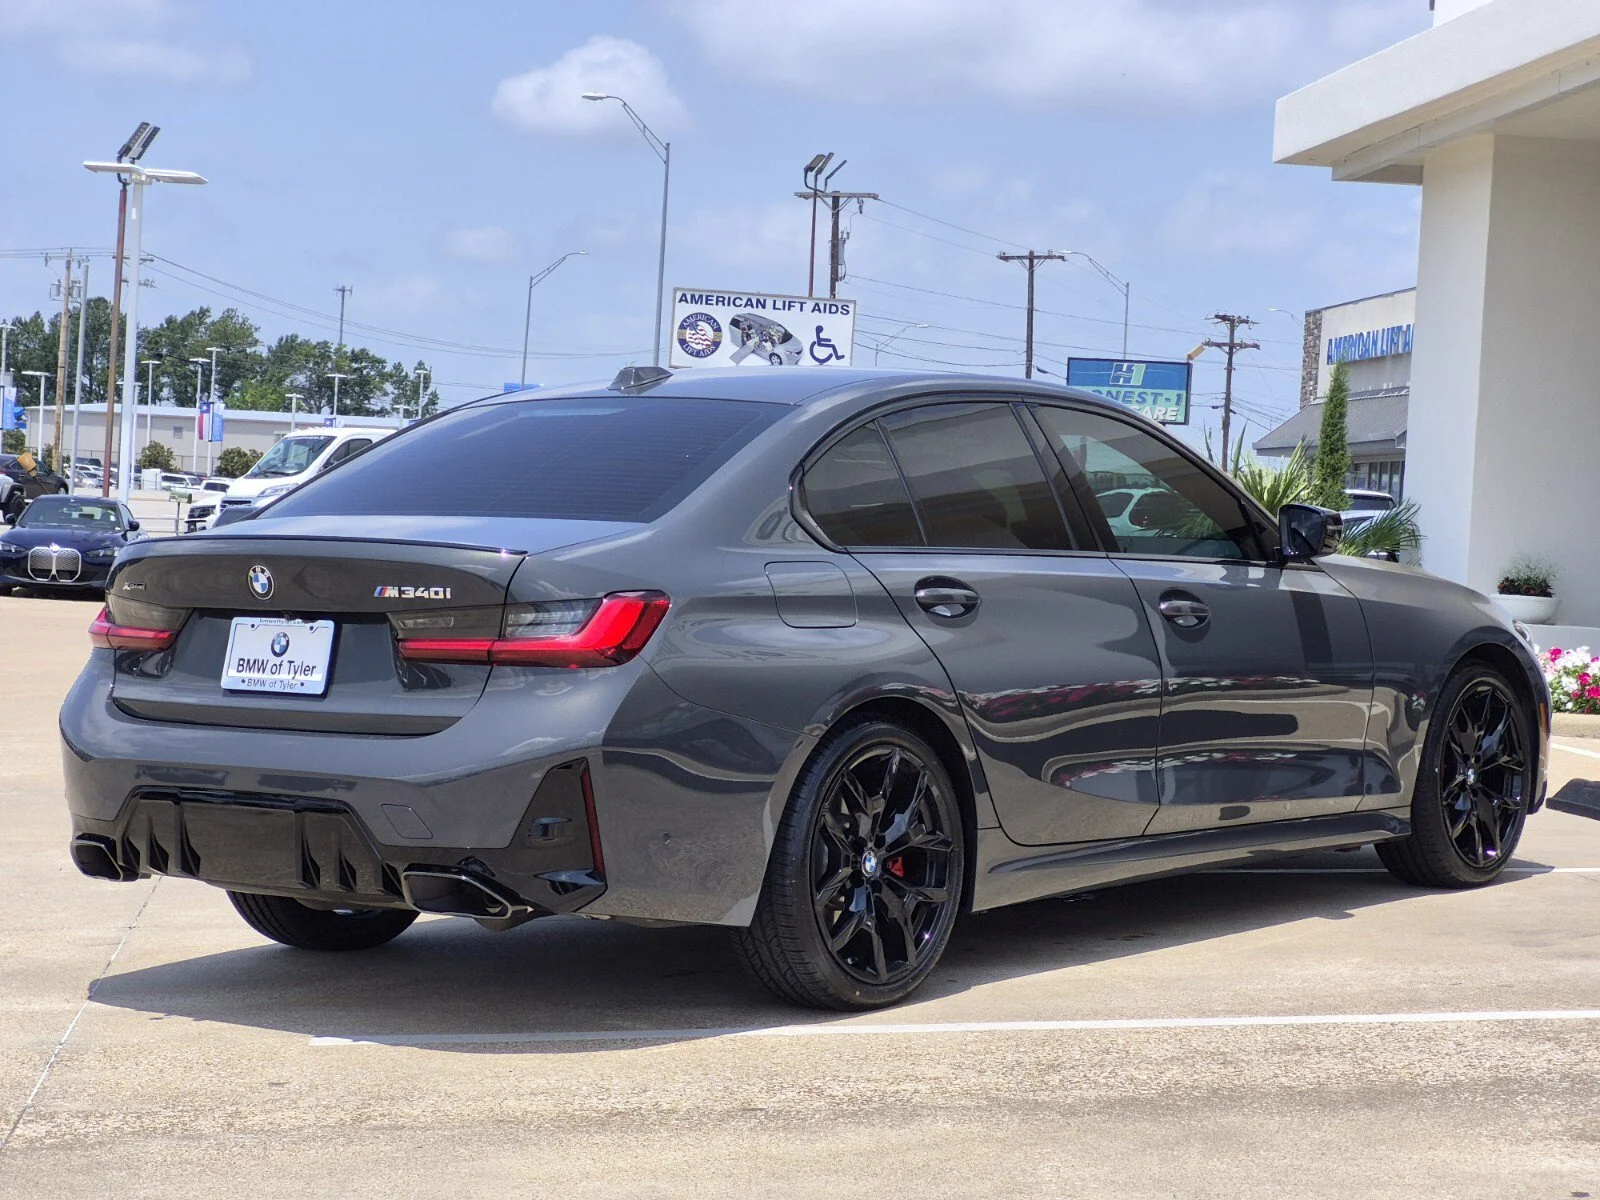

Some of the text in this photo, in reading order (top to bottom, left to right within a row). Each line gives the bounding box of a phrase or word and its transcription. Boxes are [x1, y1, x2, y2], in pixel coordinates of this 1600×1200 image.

[678, 292, 851, 316] AMERICAN LIFT AIDS
[682, 314, 719, 330] AMERICAN
[682, 343, 716, 357] LIFT AIDS
[1327, 330, 1379, 365] AMERICAN
[1380, 325, 1403, 356] LIFT
[236, 657, 317, 680] BMW of Tyler
[246, 679, 297, 691] BMW of Tyler
